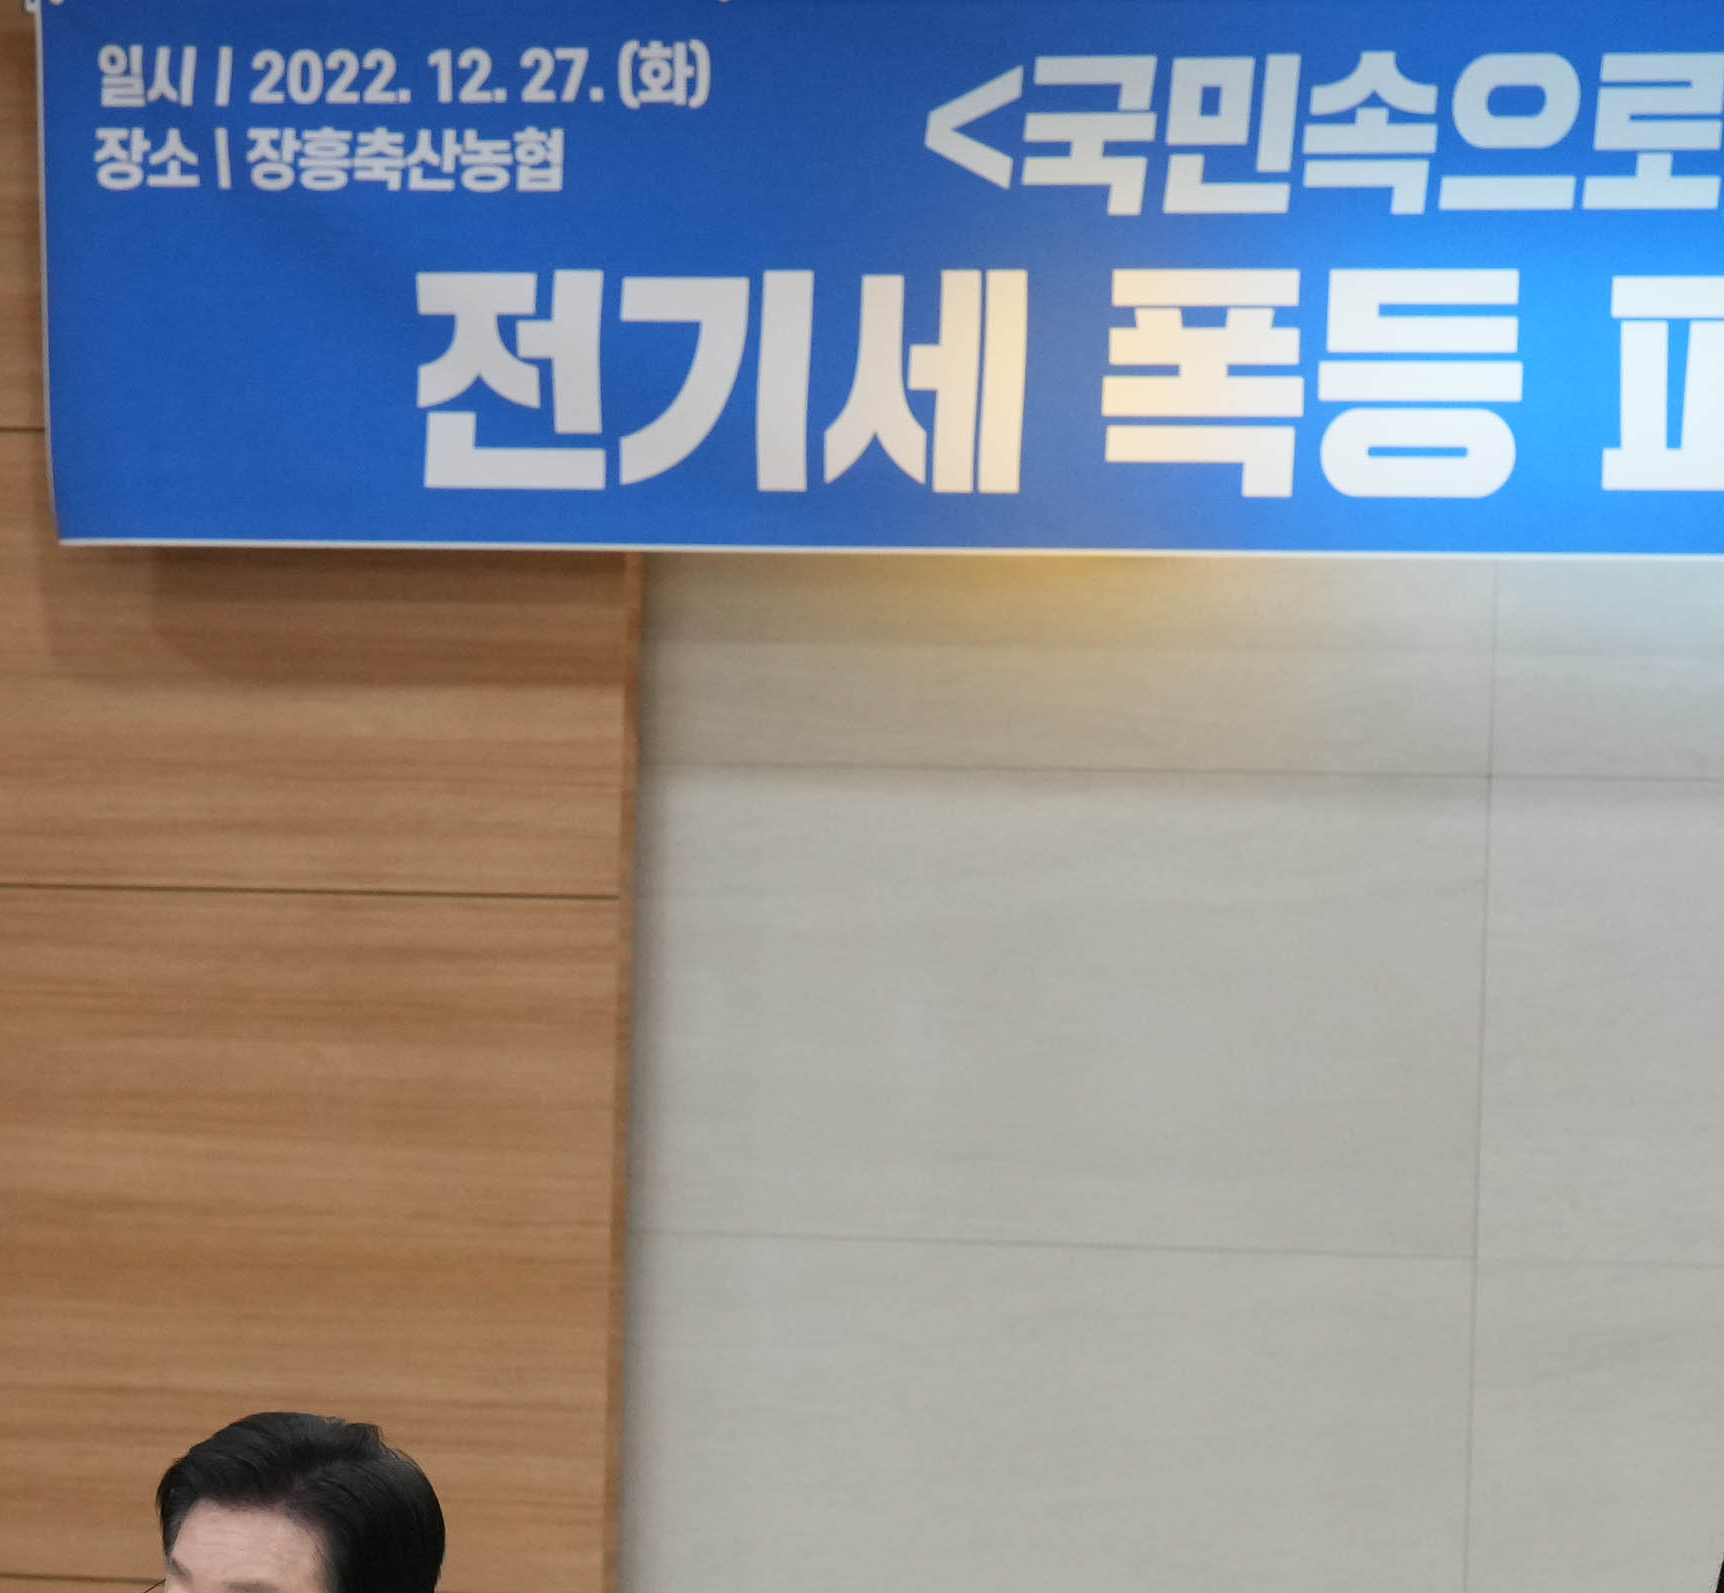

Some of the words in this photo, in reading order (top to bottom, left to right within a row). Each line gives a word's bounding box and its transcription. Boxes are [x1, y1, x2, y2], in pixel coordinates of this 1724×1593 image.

[99, 45, 197, 107] 일시
[251, 49, 411, 105] 2022.
[428, 48, 507, 104] 12.
[521, 47, 604, 104] 27.
[619, 39, 711, 109] (화)
[94, 127, 200, 191] 장소
[246, 127, 565, 193] 장흥축산농협
[416, 268, 1029, 496] 전기세
[1100, 267, 1525, 500] 폭등
